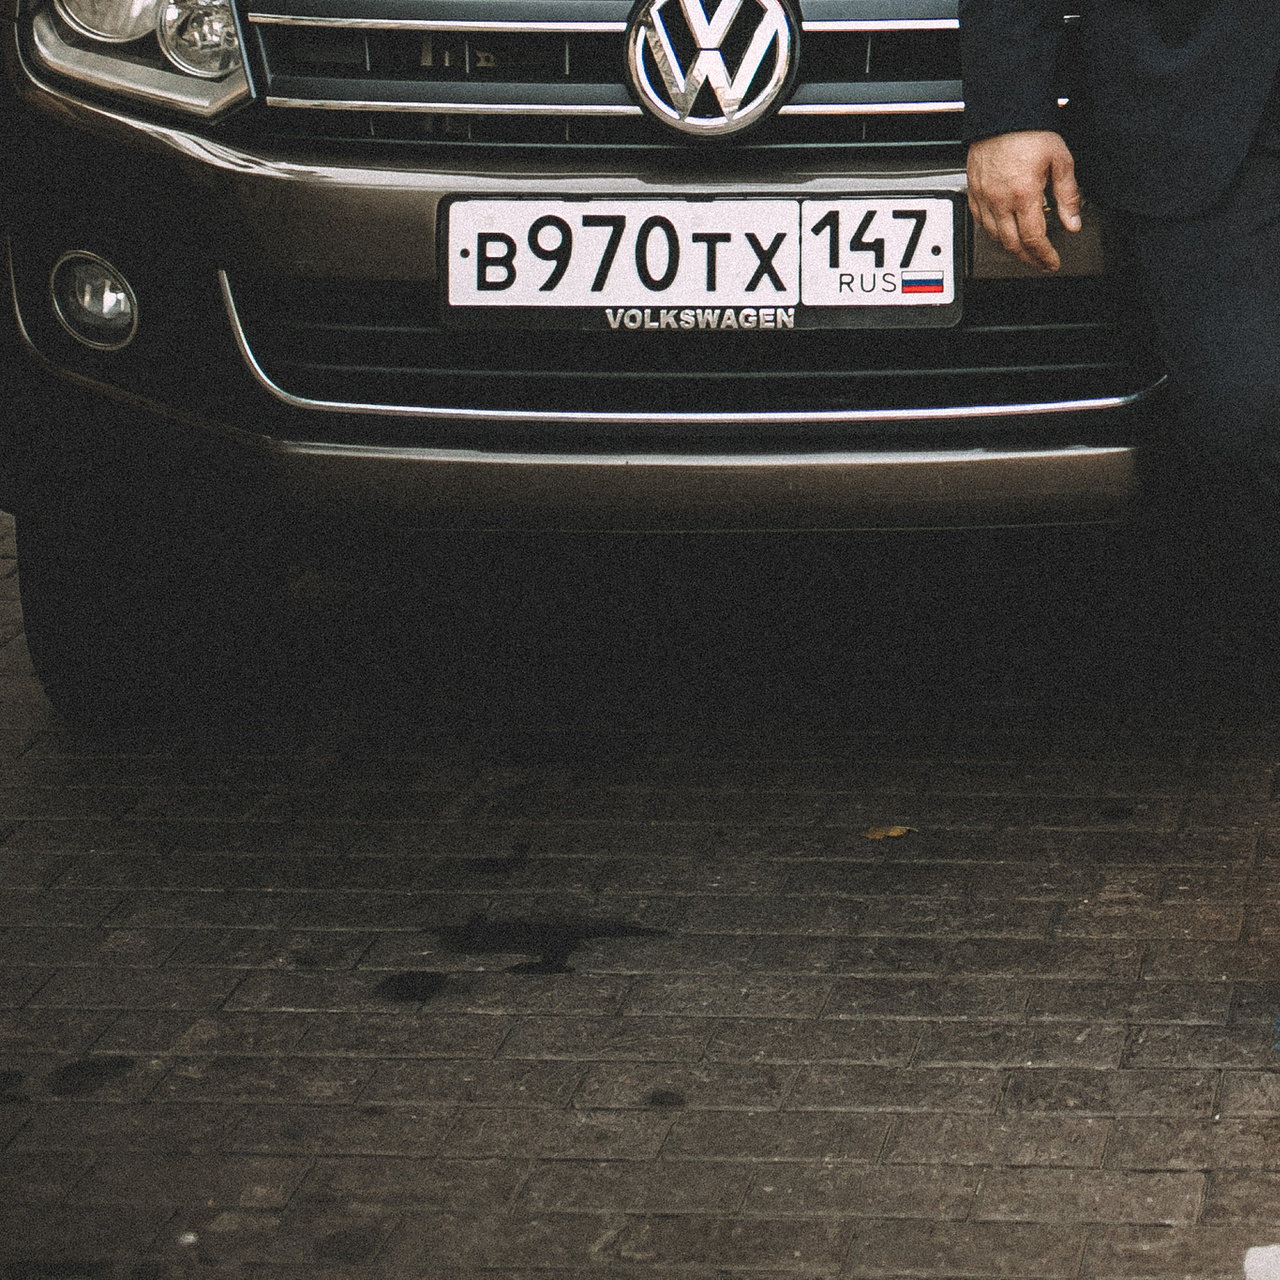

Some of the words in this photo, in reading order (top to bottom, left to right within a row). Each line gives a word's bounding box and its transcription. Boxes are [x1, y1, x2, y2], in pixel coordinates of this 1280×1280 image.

[811, 209, 927, 269] 147
[838, 272, 897, 293] RUS
[604, 307, 796, 330] VOLKSWAGEN
